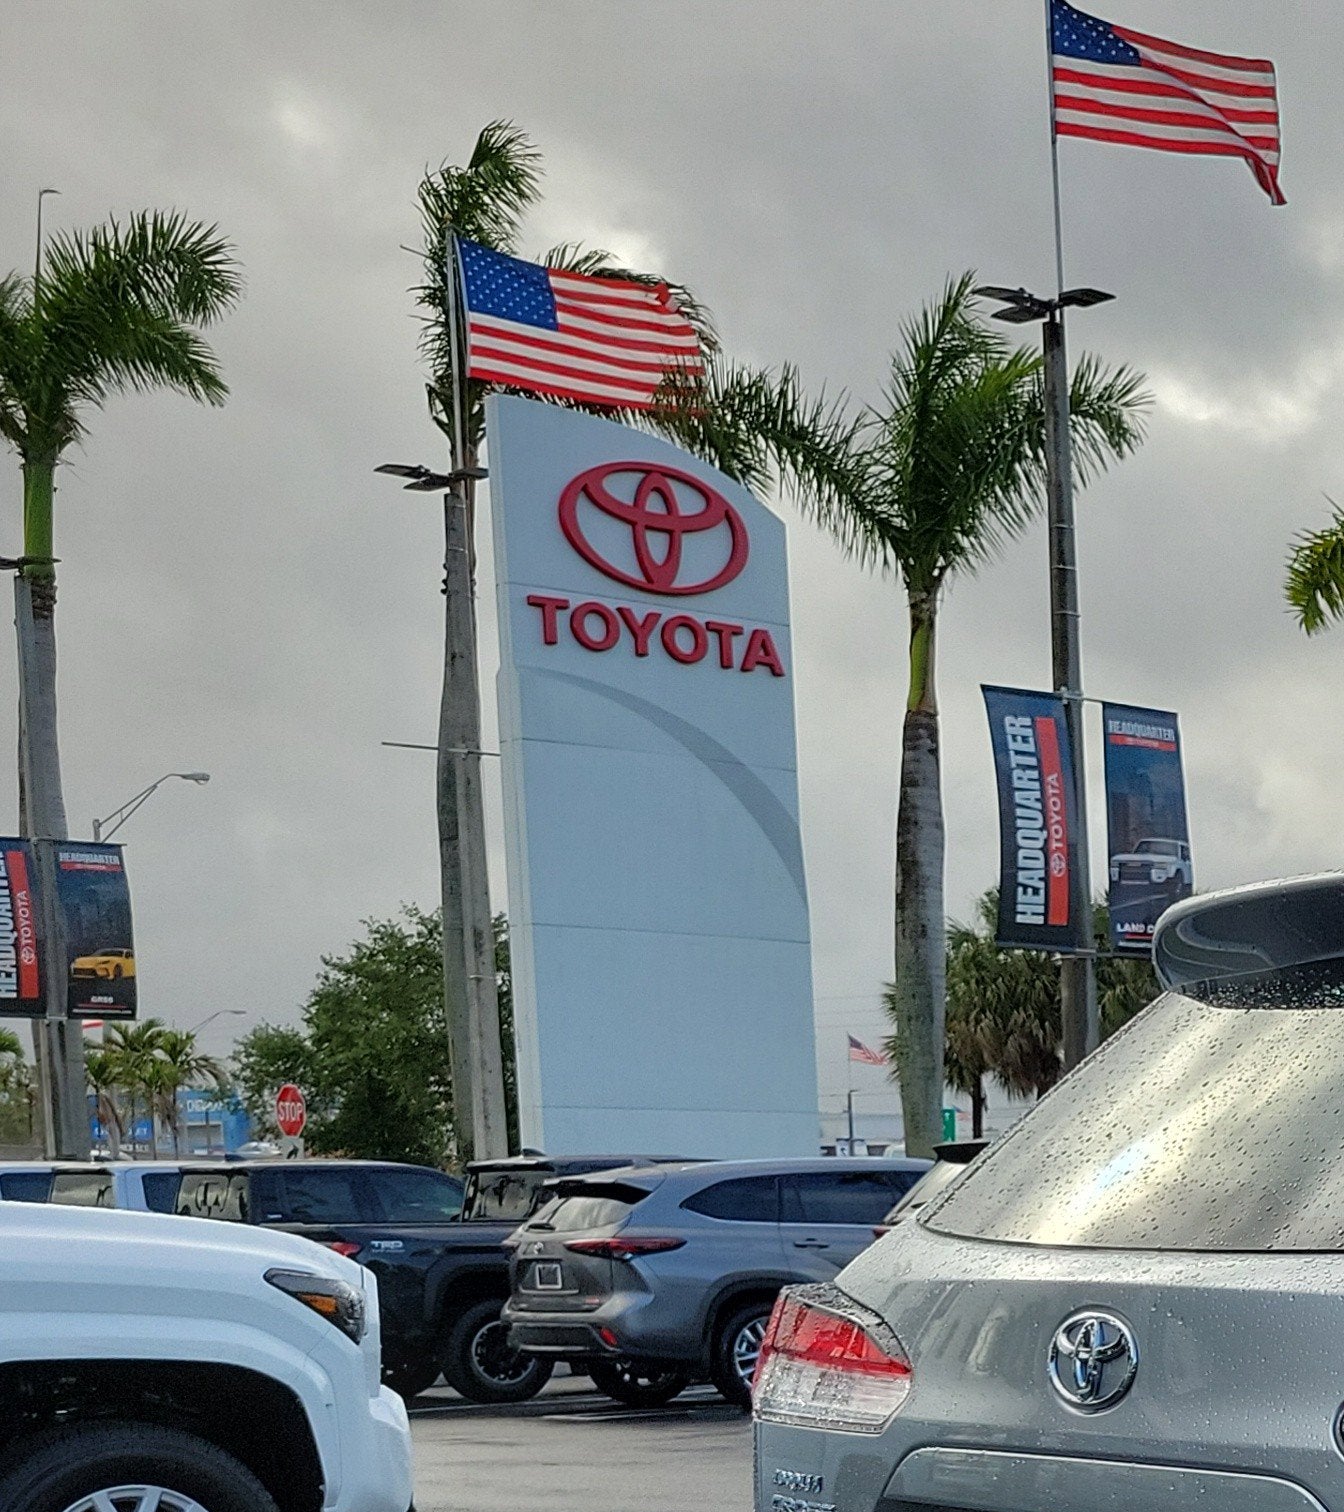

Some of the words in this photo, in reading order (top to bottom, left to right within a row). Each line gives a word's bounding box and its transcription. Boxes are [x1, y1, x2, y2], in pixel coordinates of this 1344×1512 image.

[527, 594, 785, 677] TOYOTA
[1004, 715, 1048, 925] HEADQUARTER
[1047, 772, 1064, 851] TOYOTA
[17, 891, 32, 945] TOYOTA
[1116, 922, 1146, 933] LAND
[278, 1101, 303, 1122] STOP
